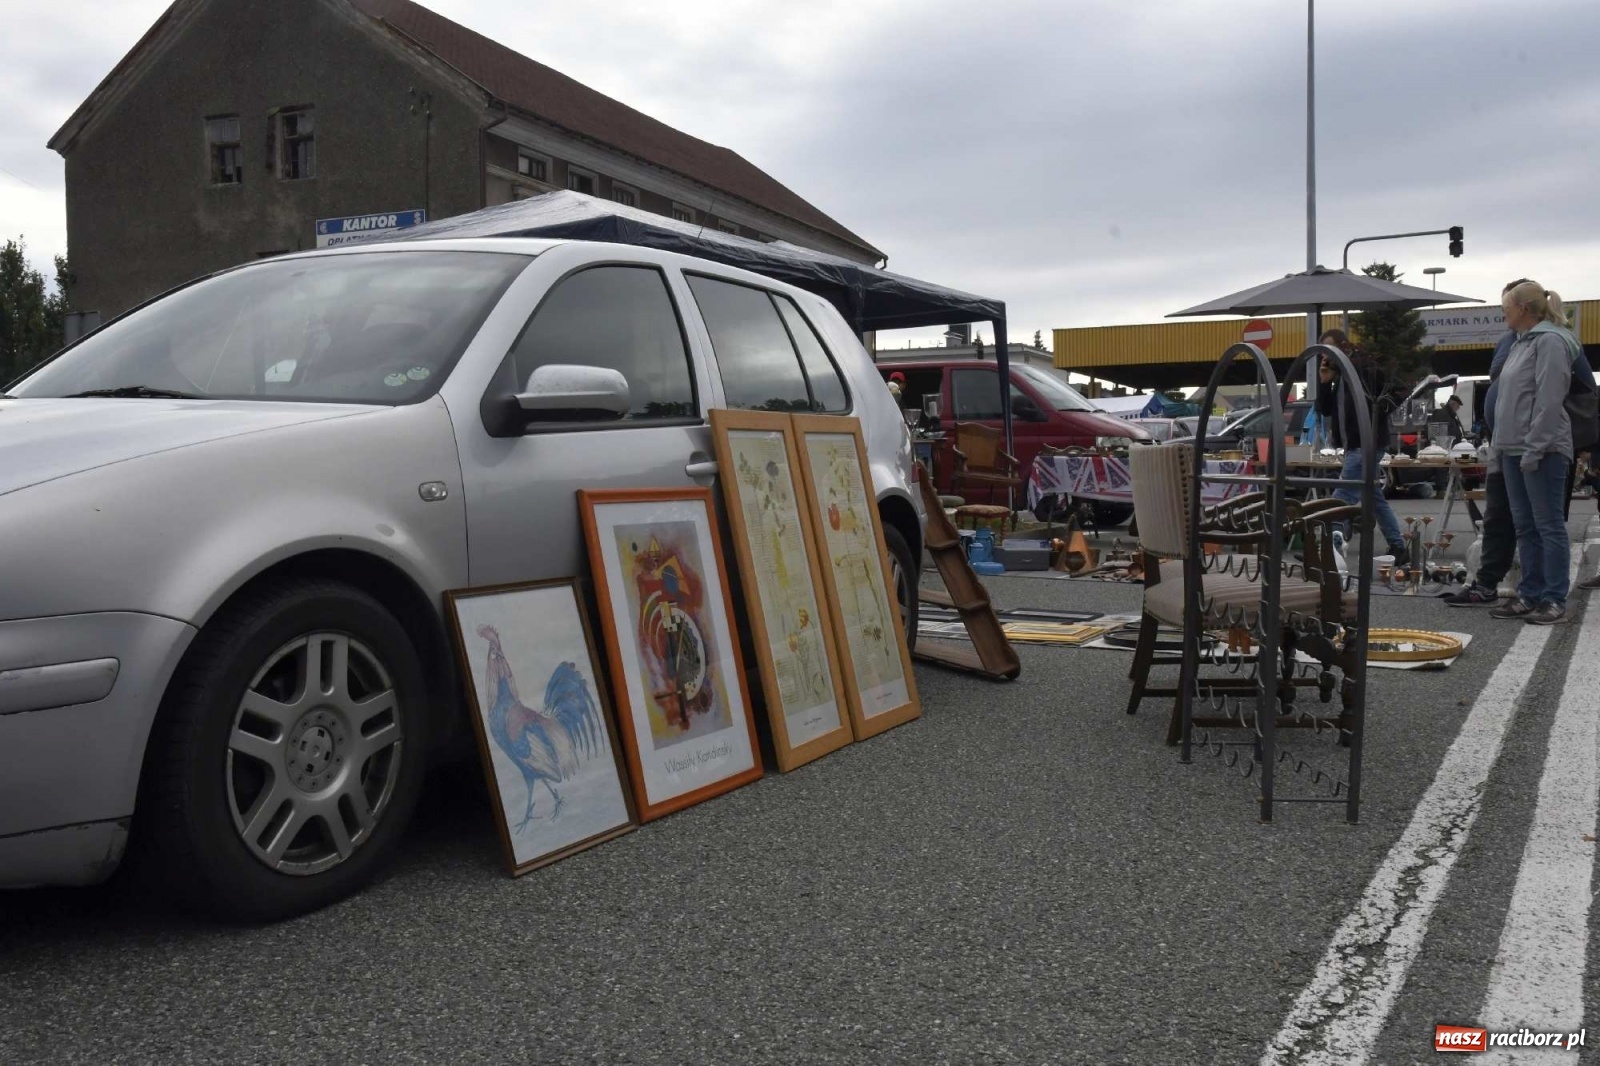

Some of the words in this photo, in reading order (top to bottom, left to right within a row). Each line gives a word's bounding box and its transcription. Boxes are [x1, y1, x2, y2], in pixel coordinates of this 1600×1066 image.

[342, 214, 398, 232] KANTOR
[1420, 317, 1468, 327] ARMARK
[1473, 315, 1490, 324] NA
[664, 753, 697, 774] Wassily
